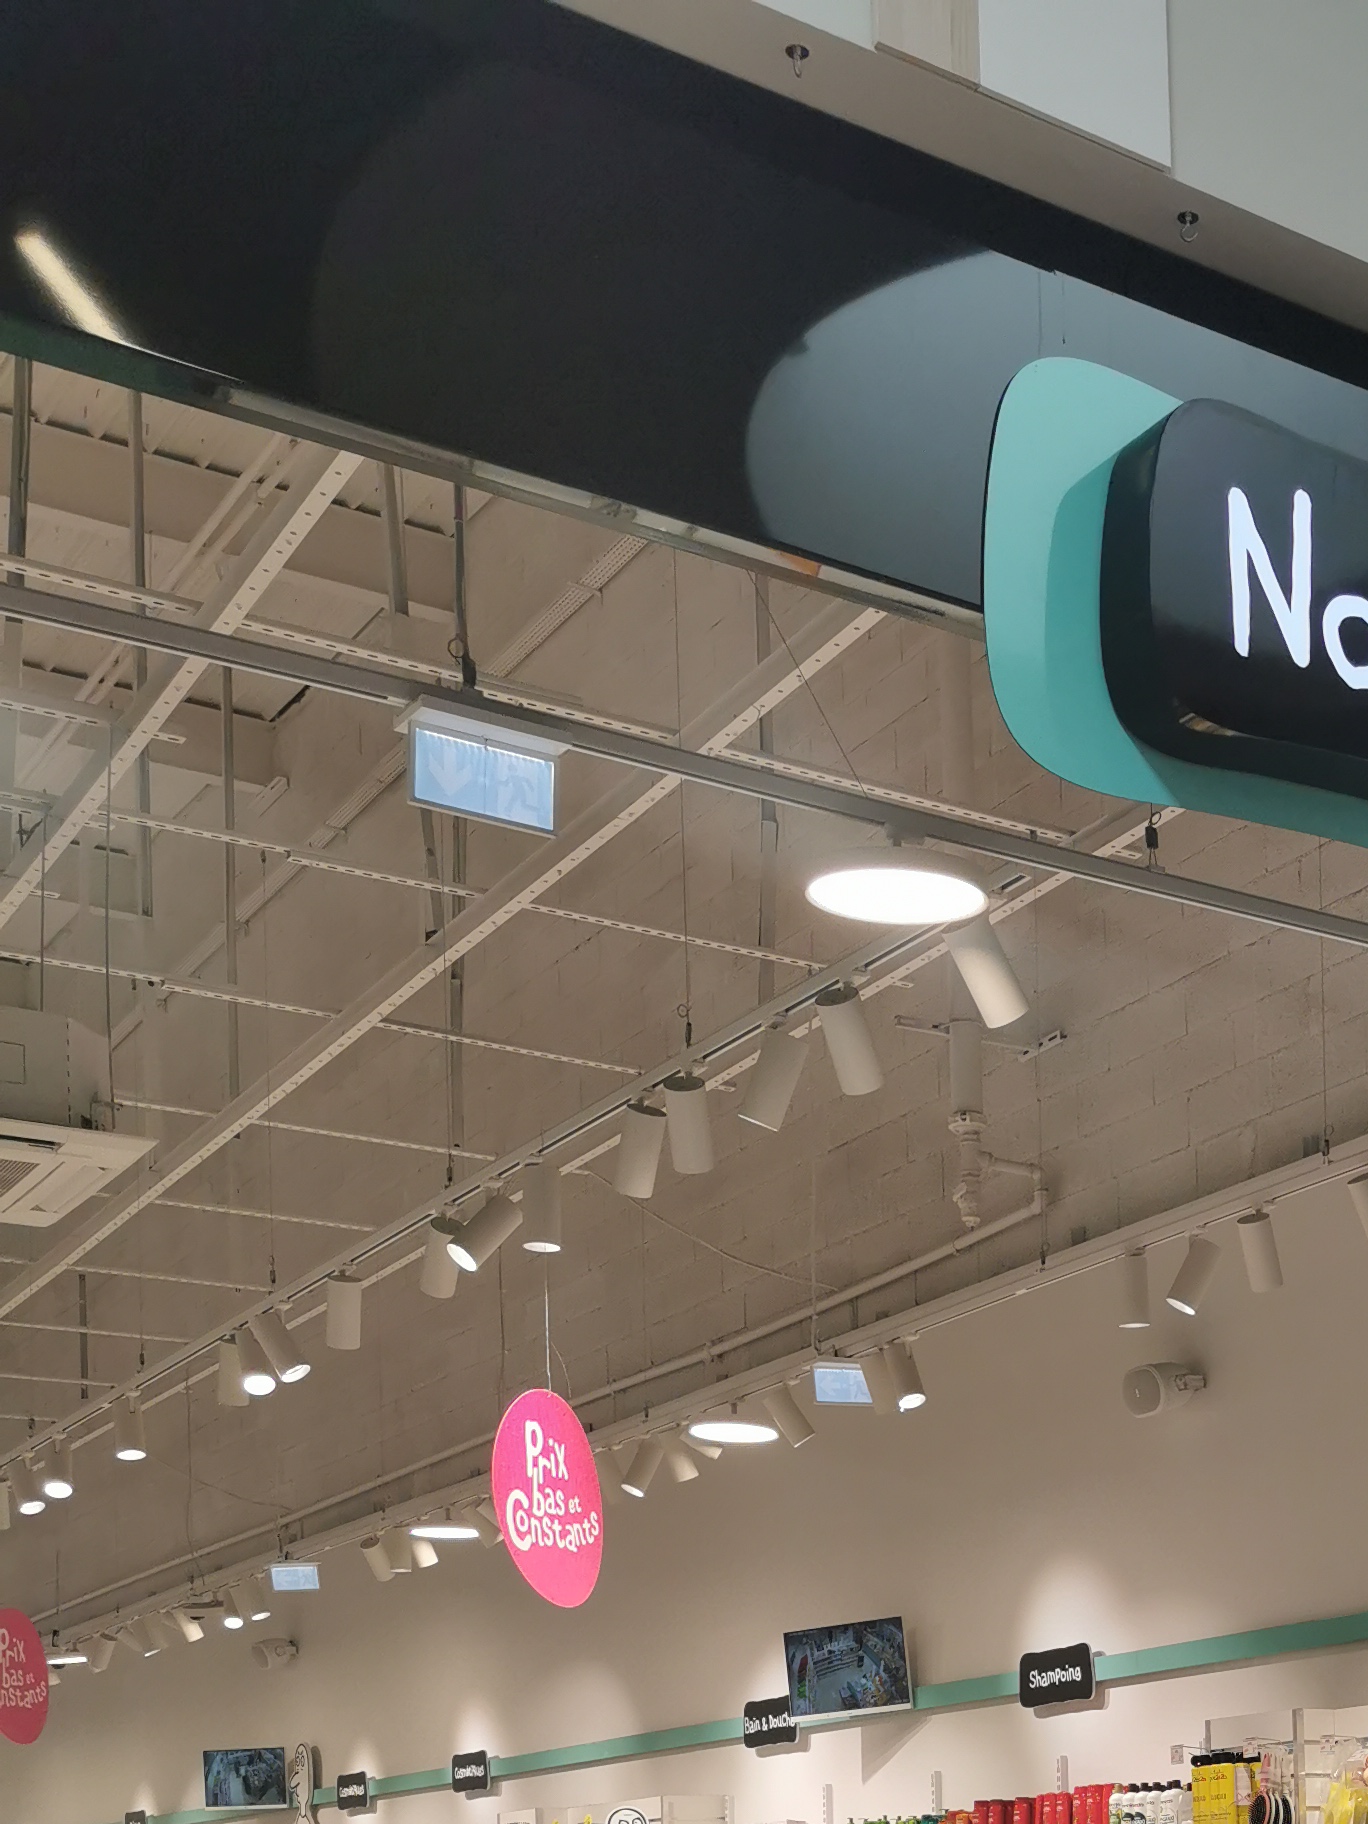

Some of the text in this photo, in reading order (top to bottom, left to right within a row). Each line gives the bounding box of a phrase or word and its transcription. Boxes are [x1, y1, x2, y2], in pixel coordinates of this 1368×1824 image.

[525, 1420, 569, 1484] Prix
[532, 1466, 582, 1517] bas et
[506, 1488, 599, 1553] Constants
[2, 1657, 24, 1688] bas
[1029, 1664, 1082, 1689] Shampoing
[0, 1681, 47, 1708] nstants
[744, 1716, 761, 1734] Bain
[762, 1716, 768, 1731] &
